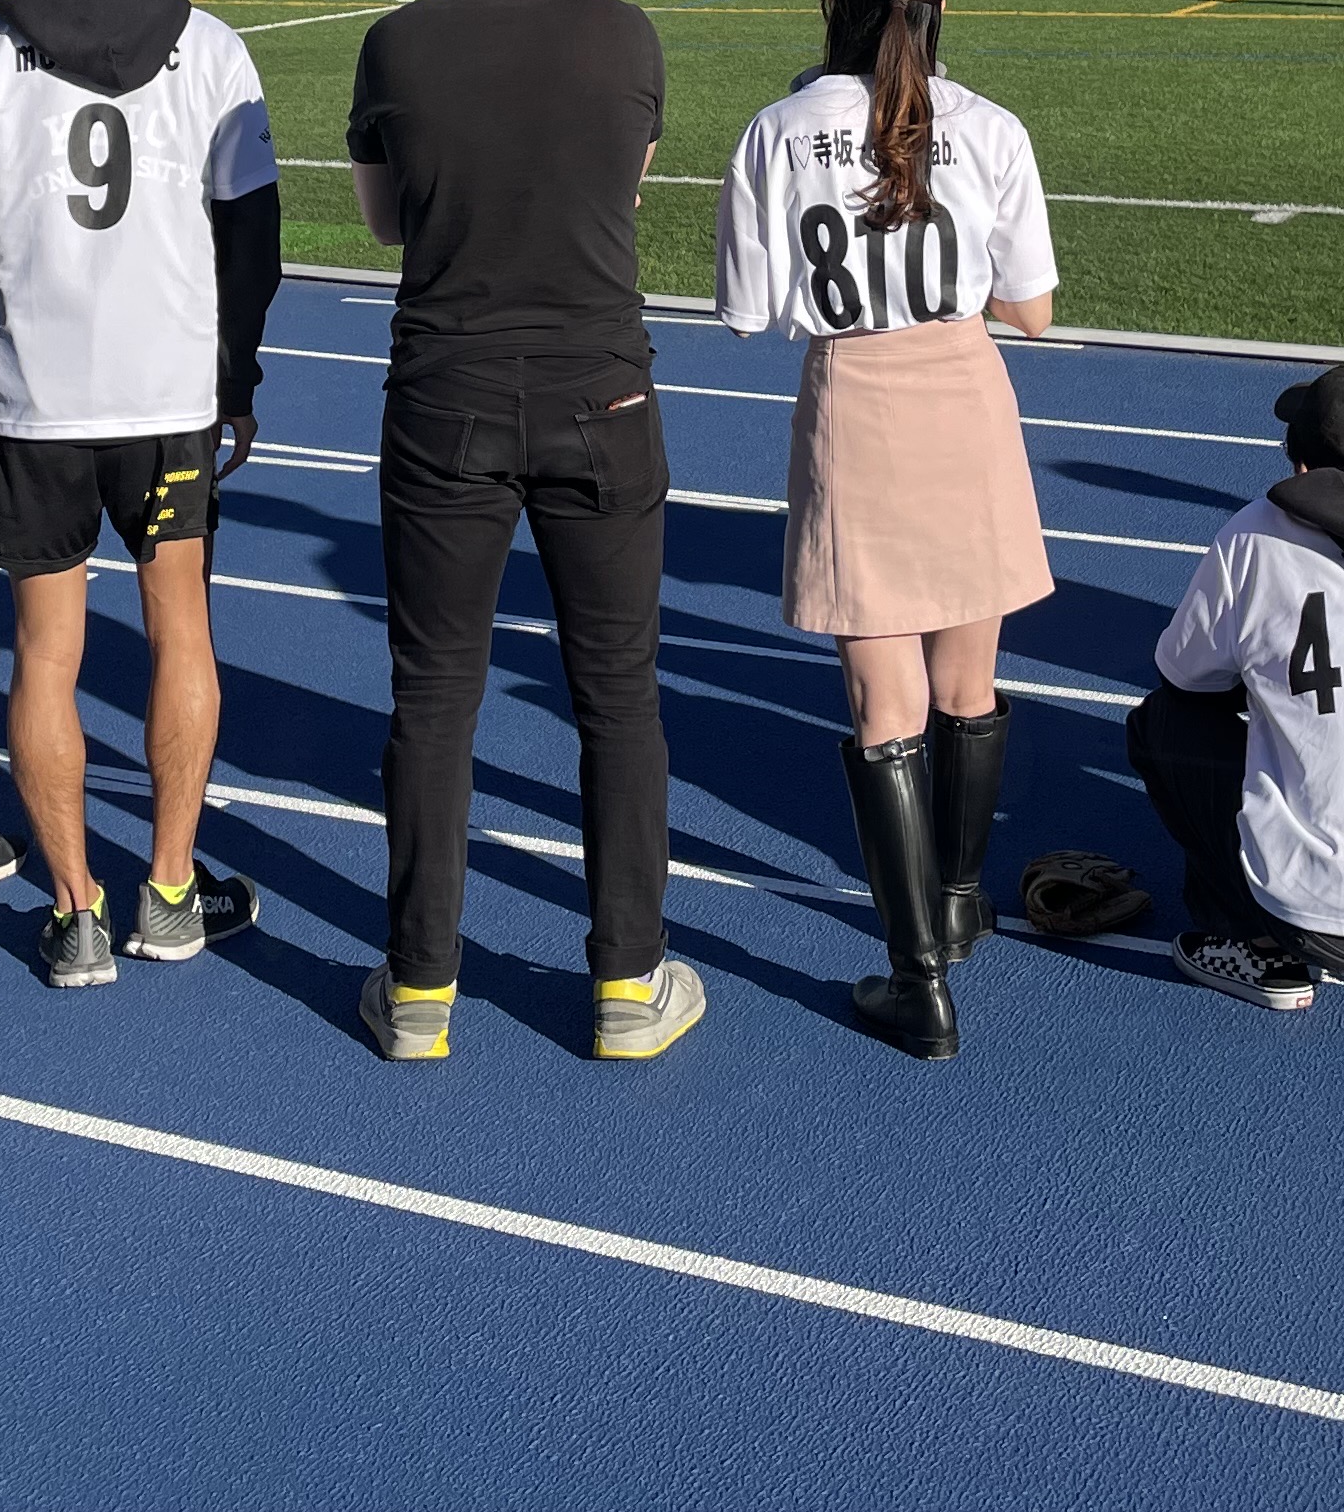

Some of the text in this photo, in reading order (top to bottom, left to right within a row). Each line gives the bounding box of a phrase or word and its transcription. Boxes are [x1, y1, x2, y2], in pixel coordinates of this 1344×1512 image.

[67, 103, 132, 230] 9
[800, 202, 959, 330] 810
[191, 893, 235, 914] HOKA
